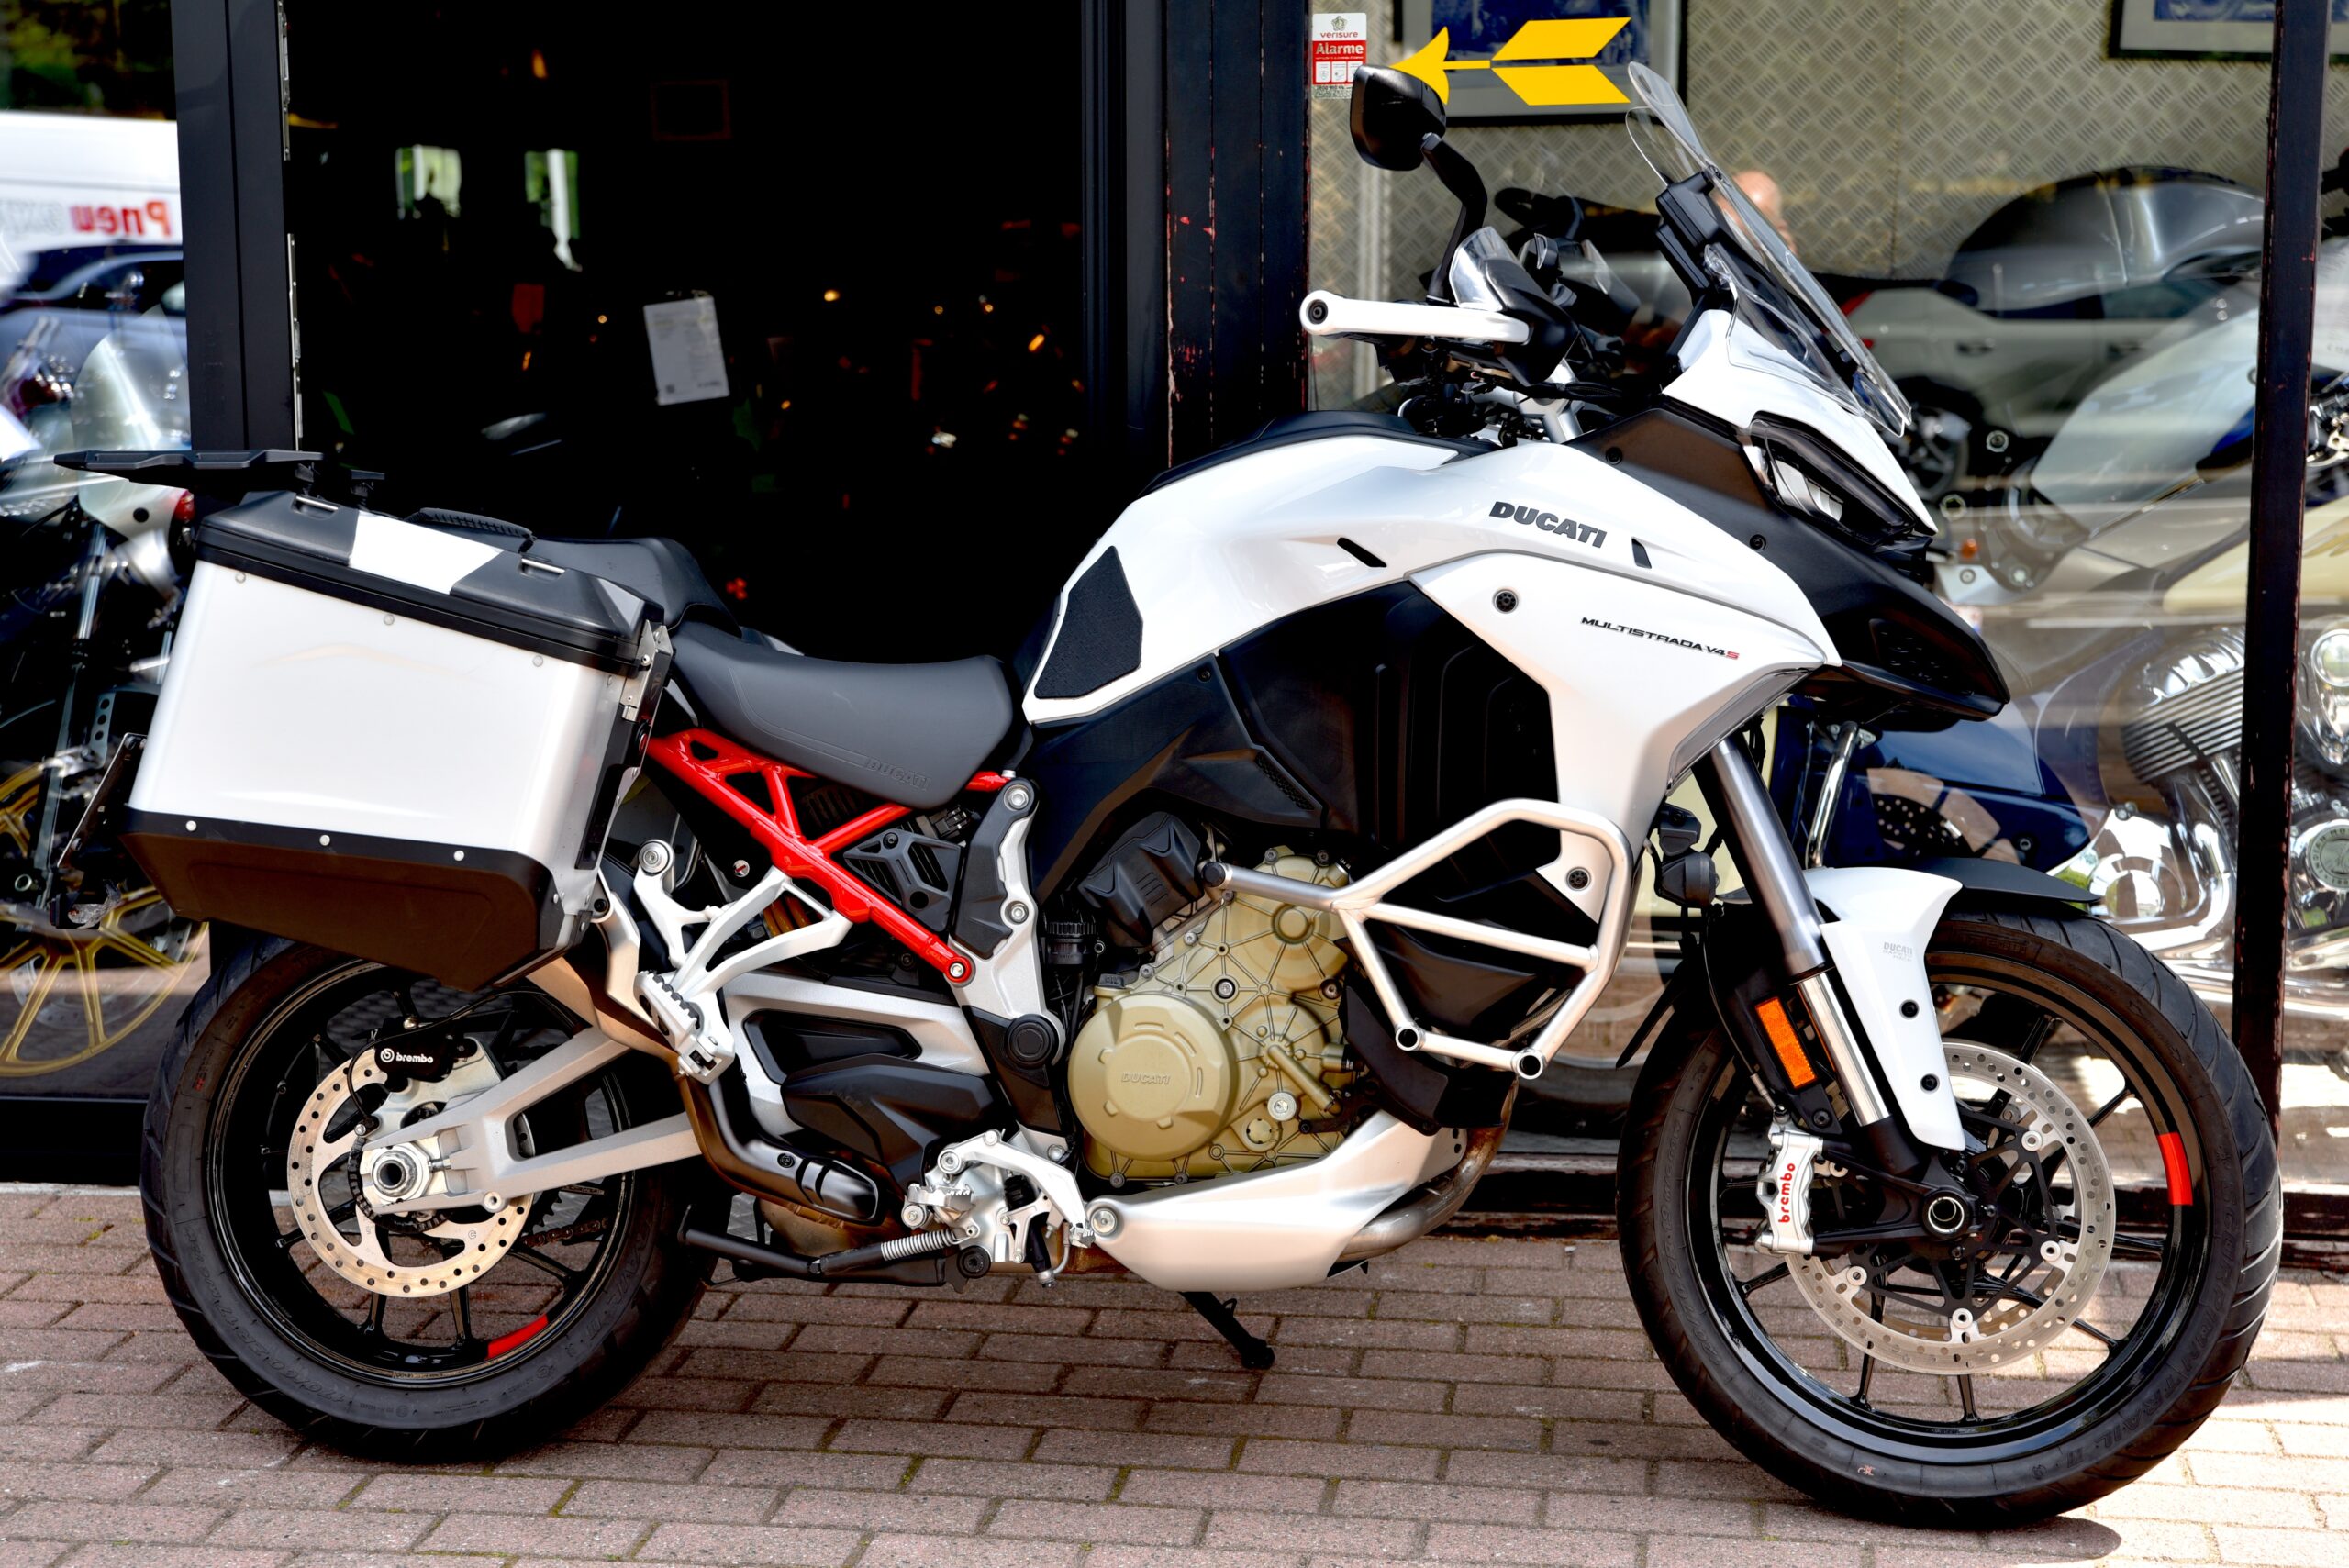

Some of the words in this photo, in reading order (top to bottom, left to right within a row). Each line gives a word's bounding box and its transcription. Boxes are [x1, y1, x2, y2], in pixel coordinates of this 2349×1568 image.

[1316, 43, 1364, 55] Alarme
[1489, 501, 1607, 549] DUCATI
[1581, 617, 1703, 651] MULTISTRADA
[1706, 645, 1740, 660] V4S
[866, 758, 930, 791] DUCATI
[1883, 941, 1913, 956] DUCATI
[395, 1052, 434, 1063] brembo
[1121, 1071, 1170, 1085] DUCATI
[1778, 1162, 1796, 1223] brembo
